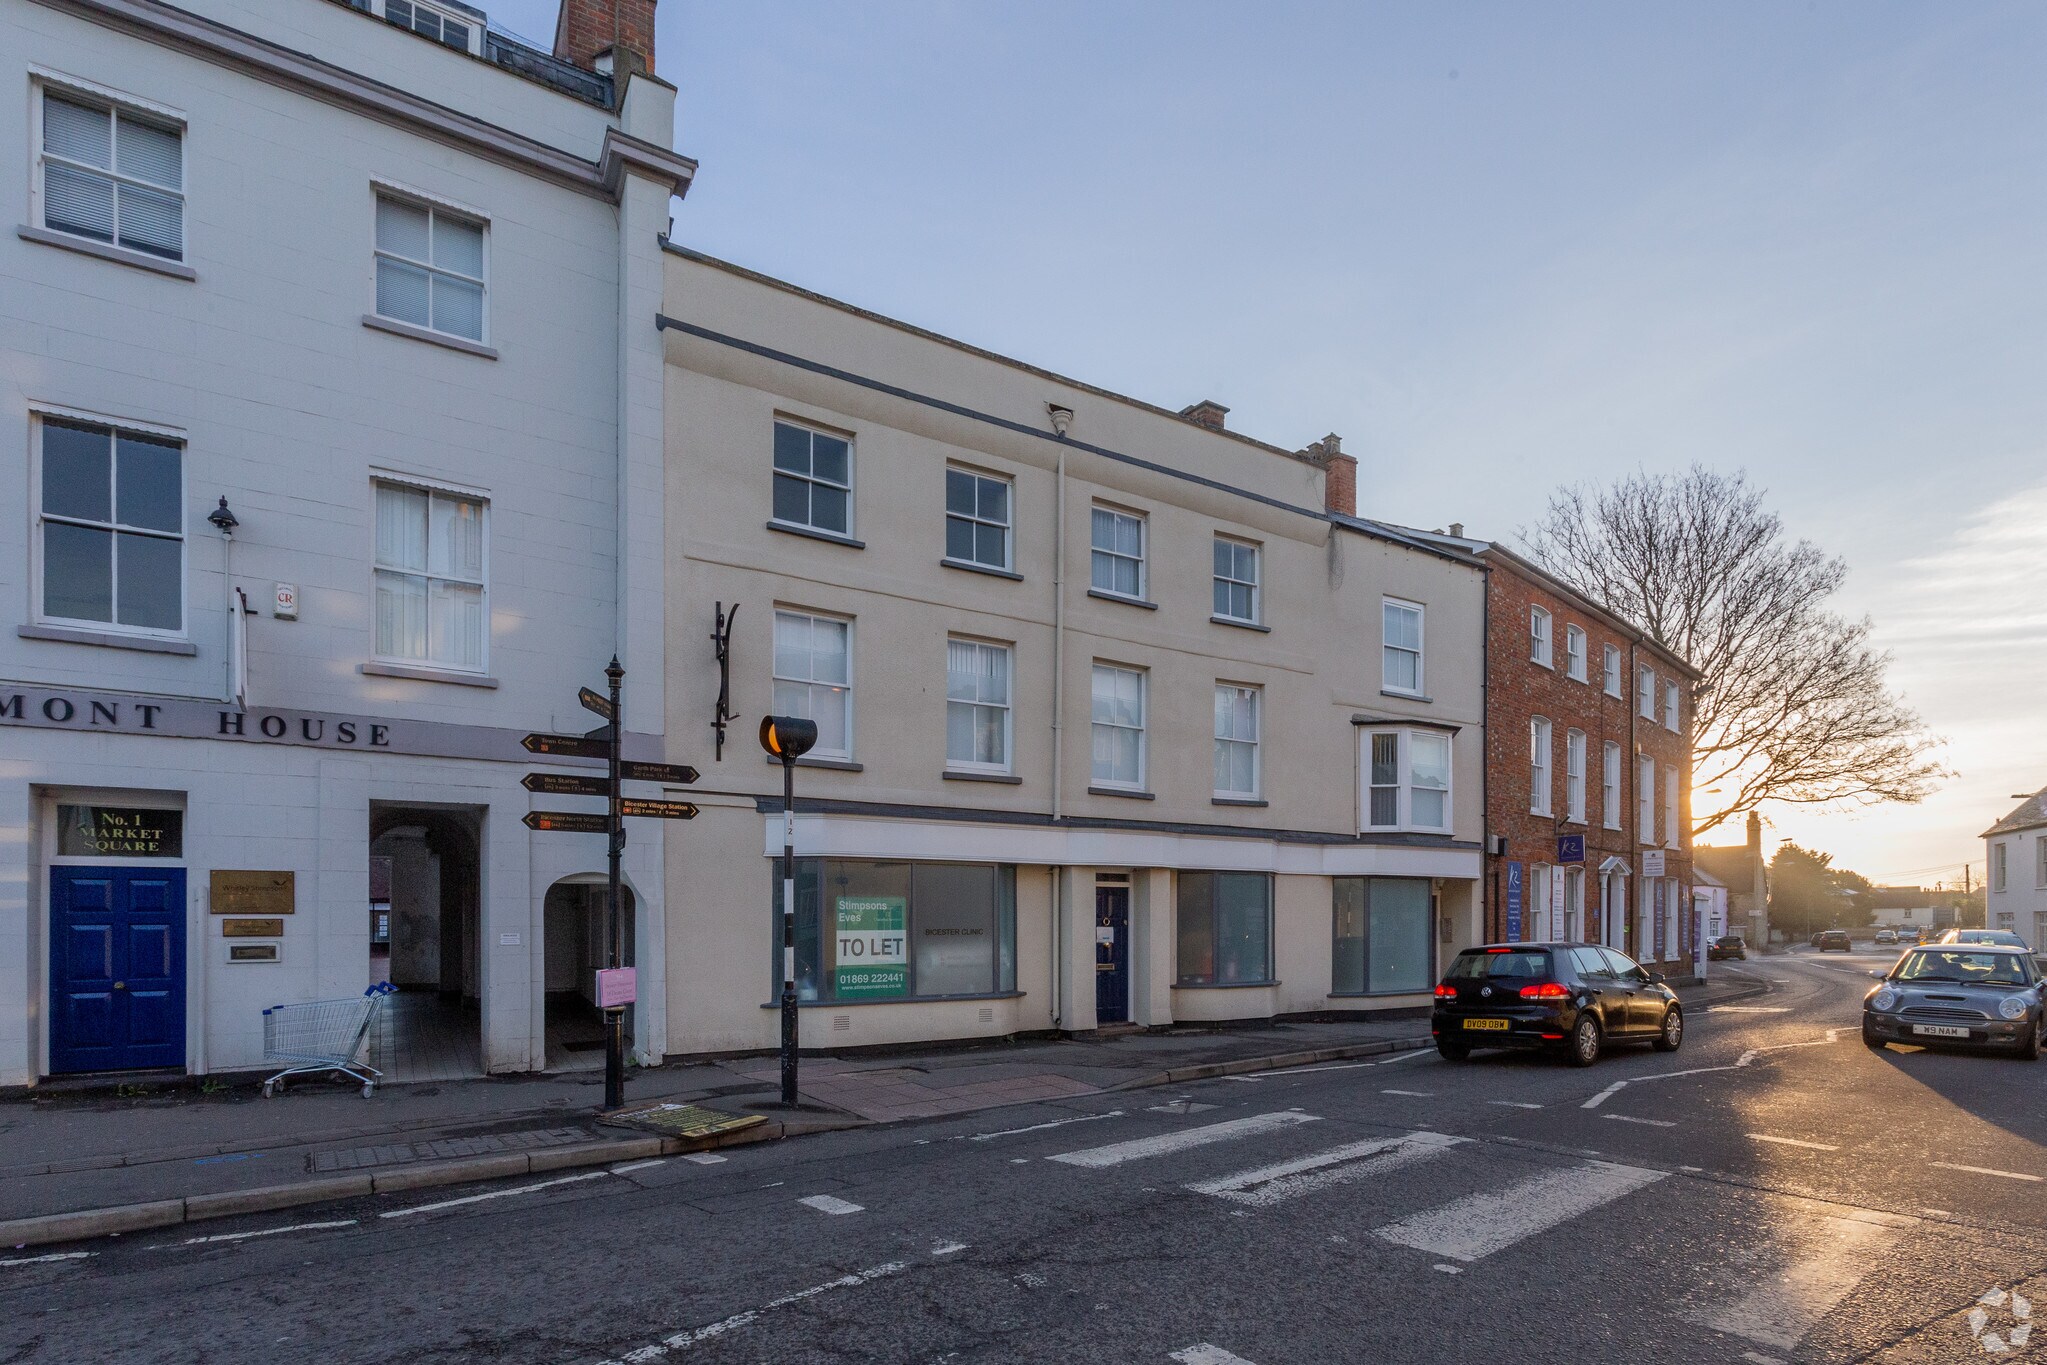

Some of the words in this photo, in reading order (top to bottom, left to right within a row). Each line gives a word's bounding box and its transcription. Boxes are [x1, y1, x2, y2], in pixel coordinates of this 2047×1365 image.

[278, 592, 293, 604] CR
[217, 710, 390, 747] HOUSE
[102, 813, 127, 826] No.
[135, 814, 141, 826] 1
[79, 827, 163, 839] MARKET
[83, 840, 160, 852] SQUARE
[838, 900, 887, 912] Stimpsons
[838, 913, 861, 922] Eves
[925, 928, 960, 936] BICESTER
[961, 928, 984, 936] CLINIC
[839, 938, 865, 957] TO
[870, 937, 904, 956] LET
[840, 974, 869, 984] 01869
[871, 973, 903, 983] 222441
[1467, 1020, 1487, 1028] DV09
[1939, 1027, 1958, 1035] NAM
